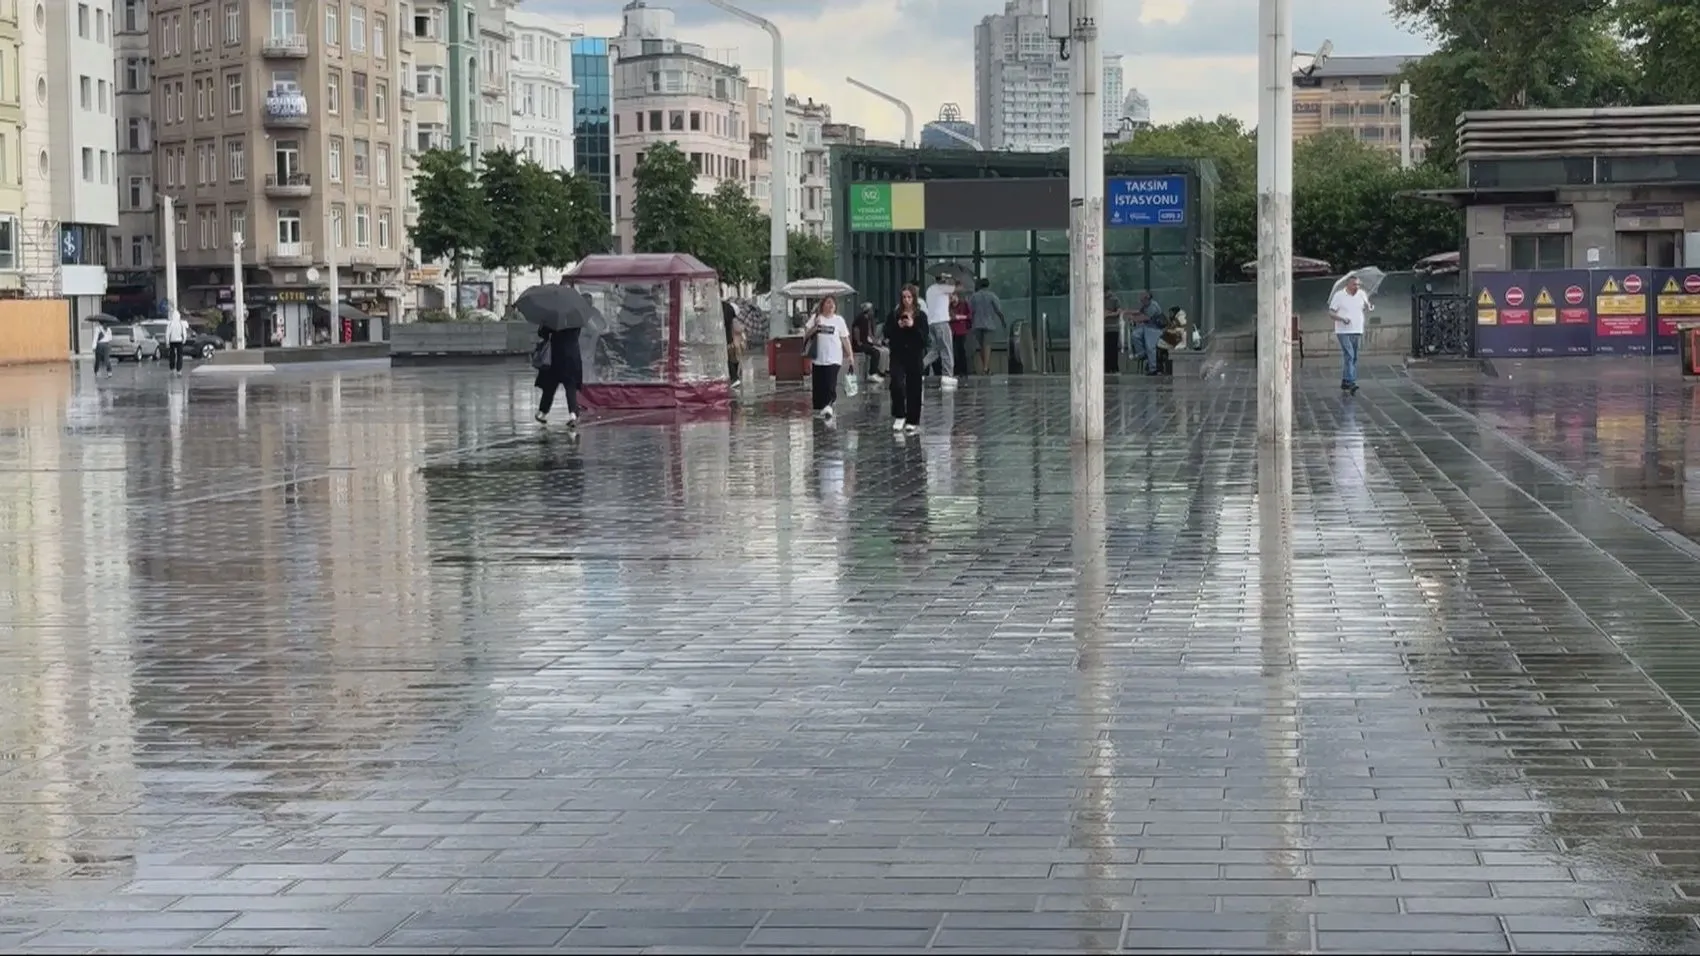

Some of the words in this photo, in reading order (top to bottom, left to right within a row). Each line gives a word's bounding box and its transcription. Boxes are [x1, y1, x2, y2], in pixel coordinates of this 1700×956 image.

[1076, 17, 1095, 26] 121
[1125, 180, 1168, 192] TAKSİM
[1114, 194, 1179, 206] İSTASYONU
